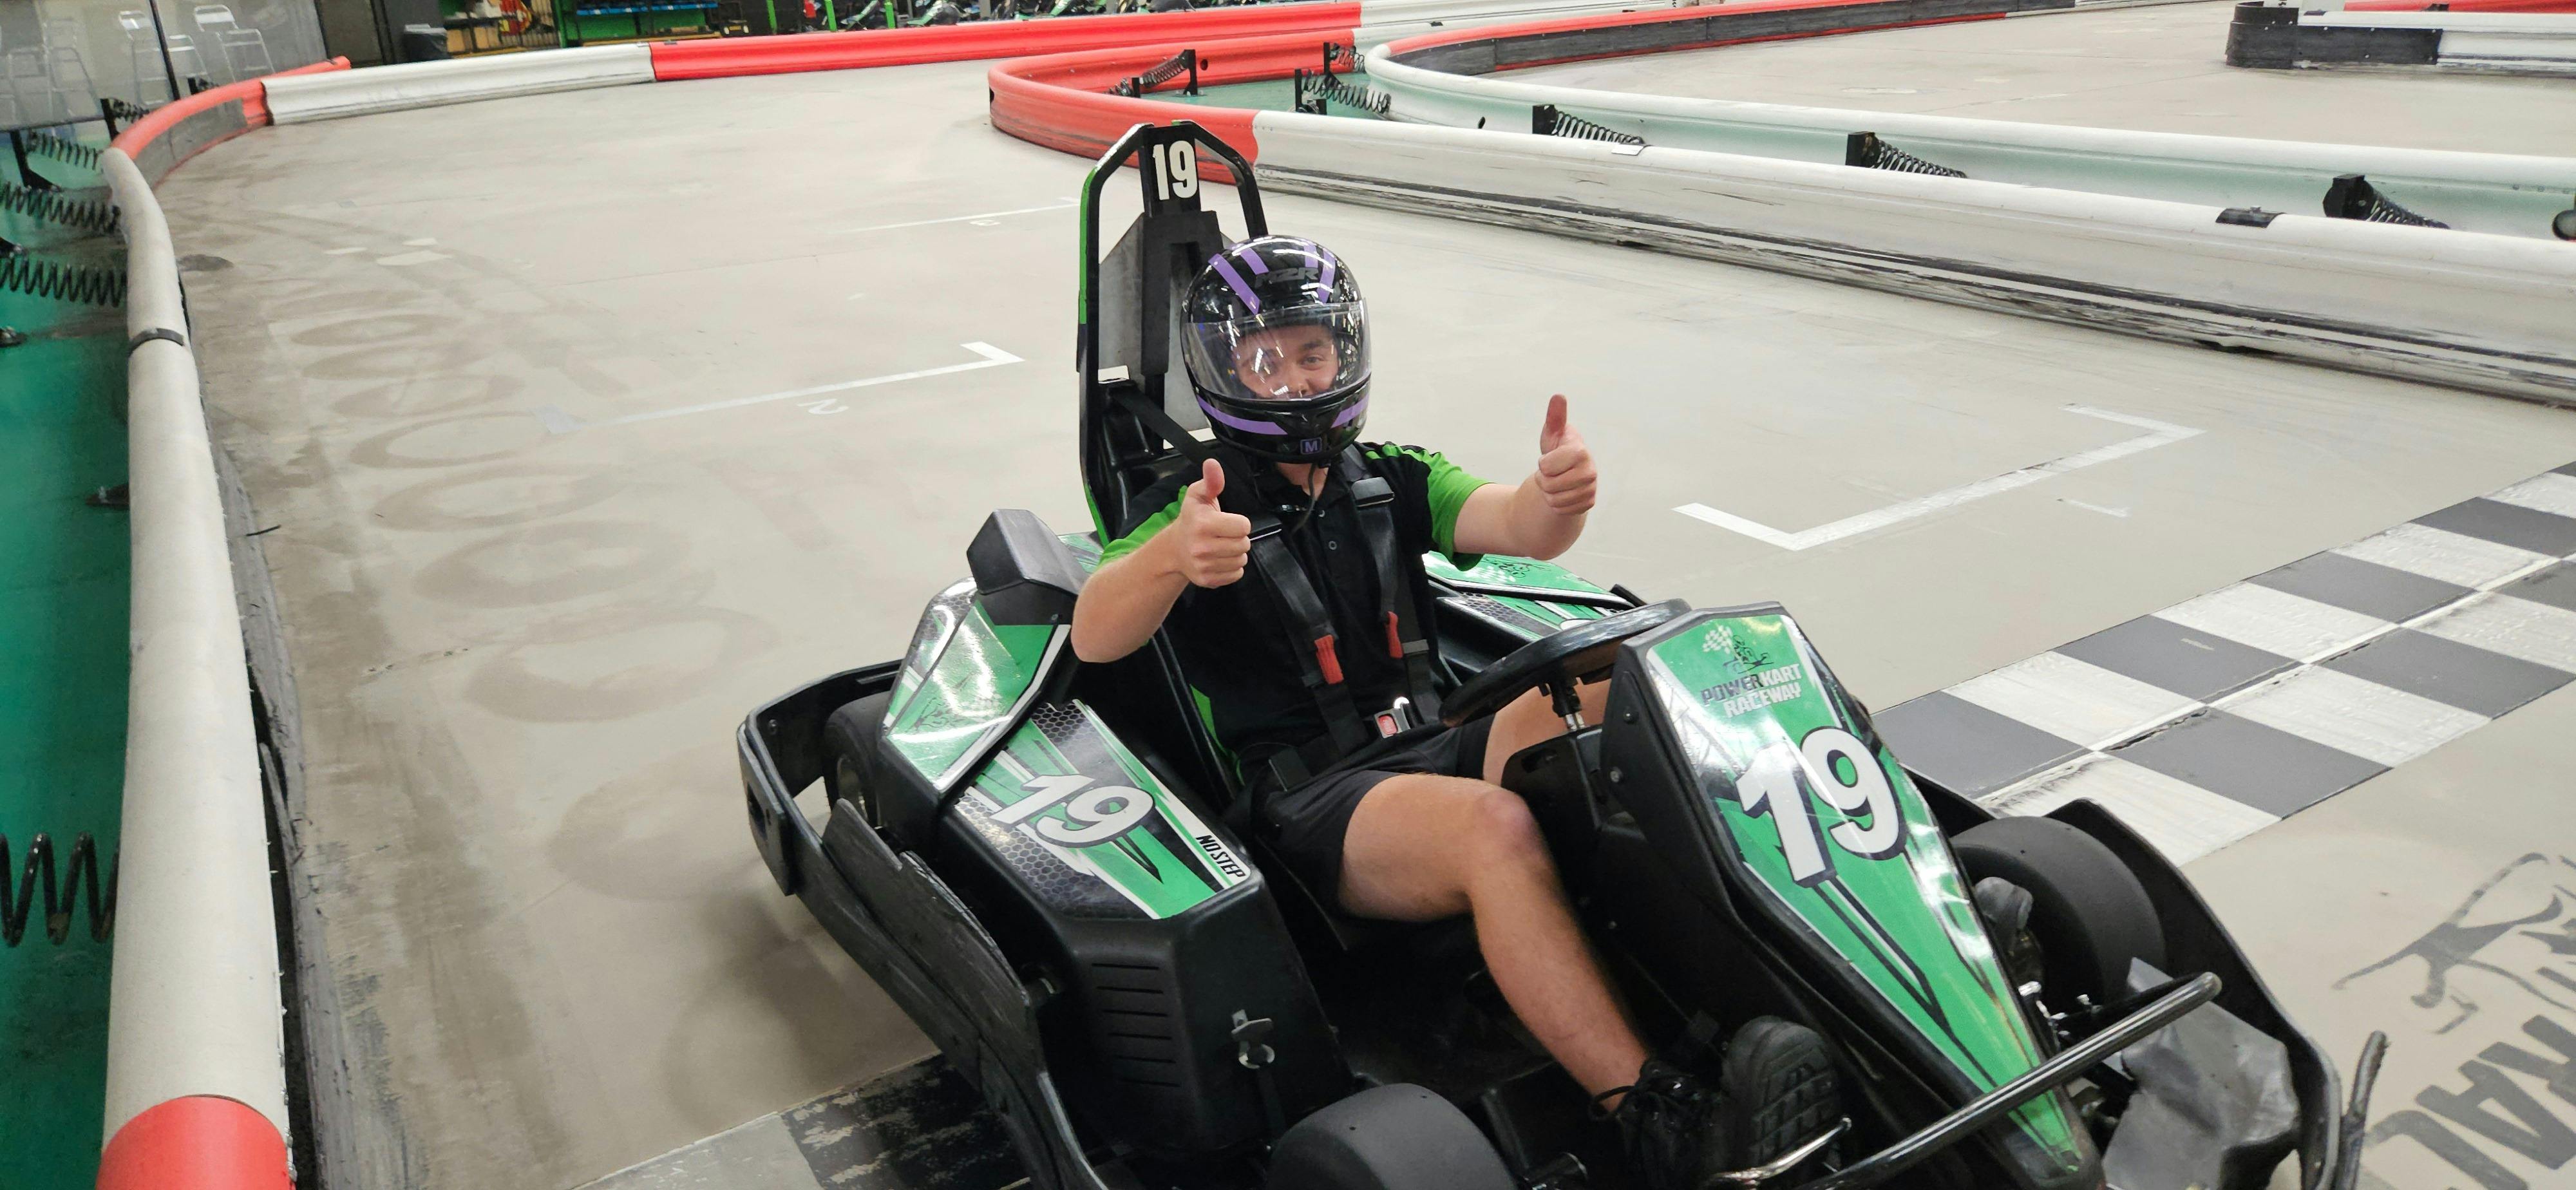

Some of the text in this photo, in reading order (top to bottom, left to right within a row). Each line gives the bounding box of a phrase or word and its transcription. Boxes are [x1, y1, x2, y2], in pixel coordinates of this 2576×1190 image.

[1152, 140, 1198, 200] 19
[1305, 440, 1318, 452] M
[1700, 664, 1802, 707] POWERKART
[1723, 682, 1802, 719] RACEWAY
[988, 774, 1155, 847] 19
[1736, 726, 1904, 885] 19
[1195, 835, 1246, 878] NO STEP
